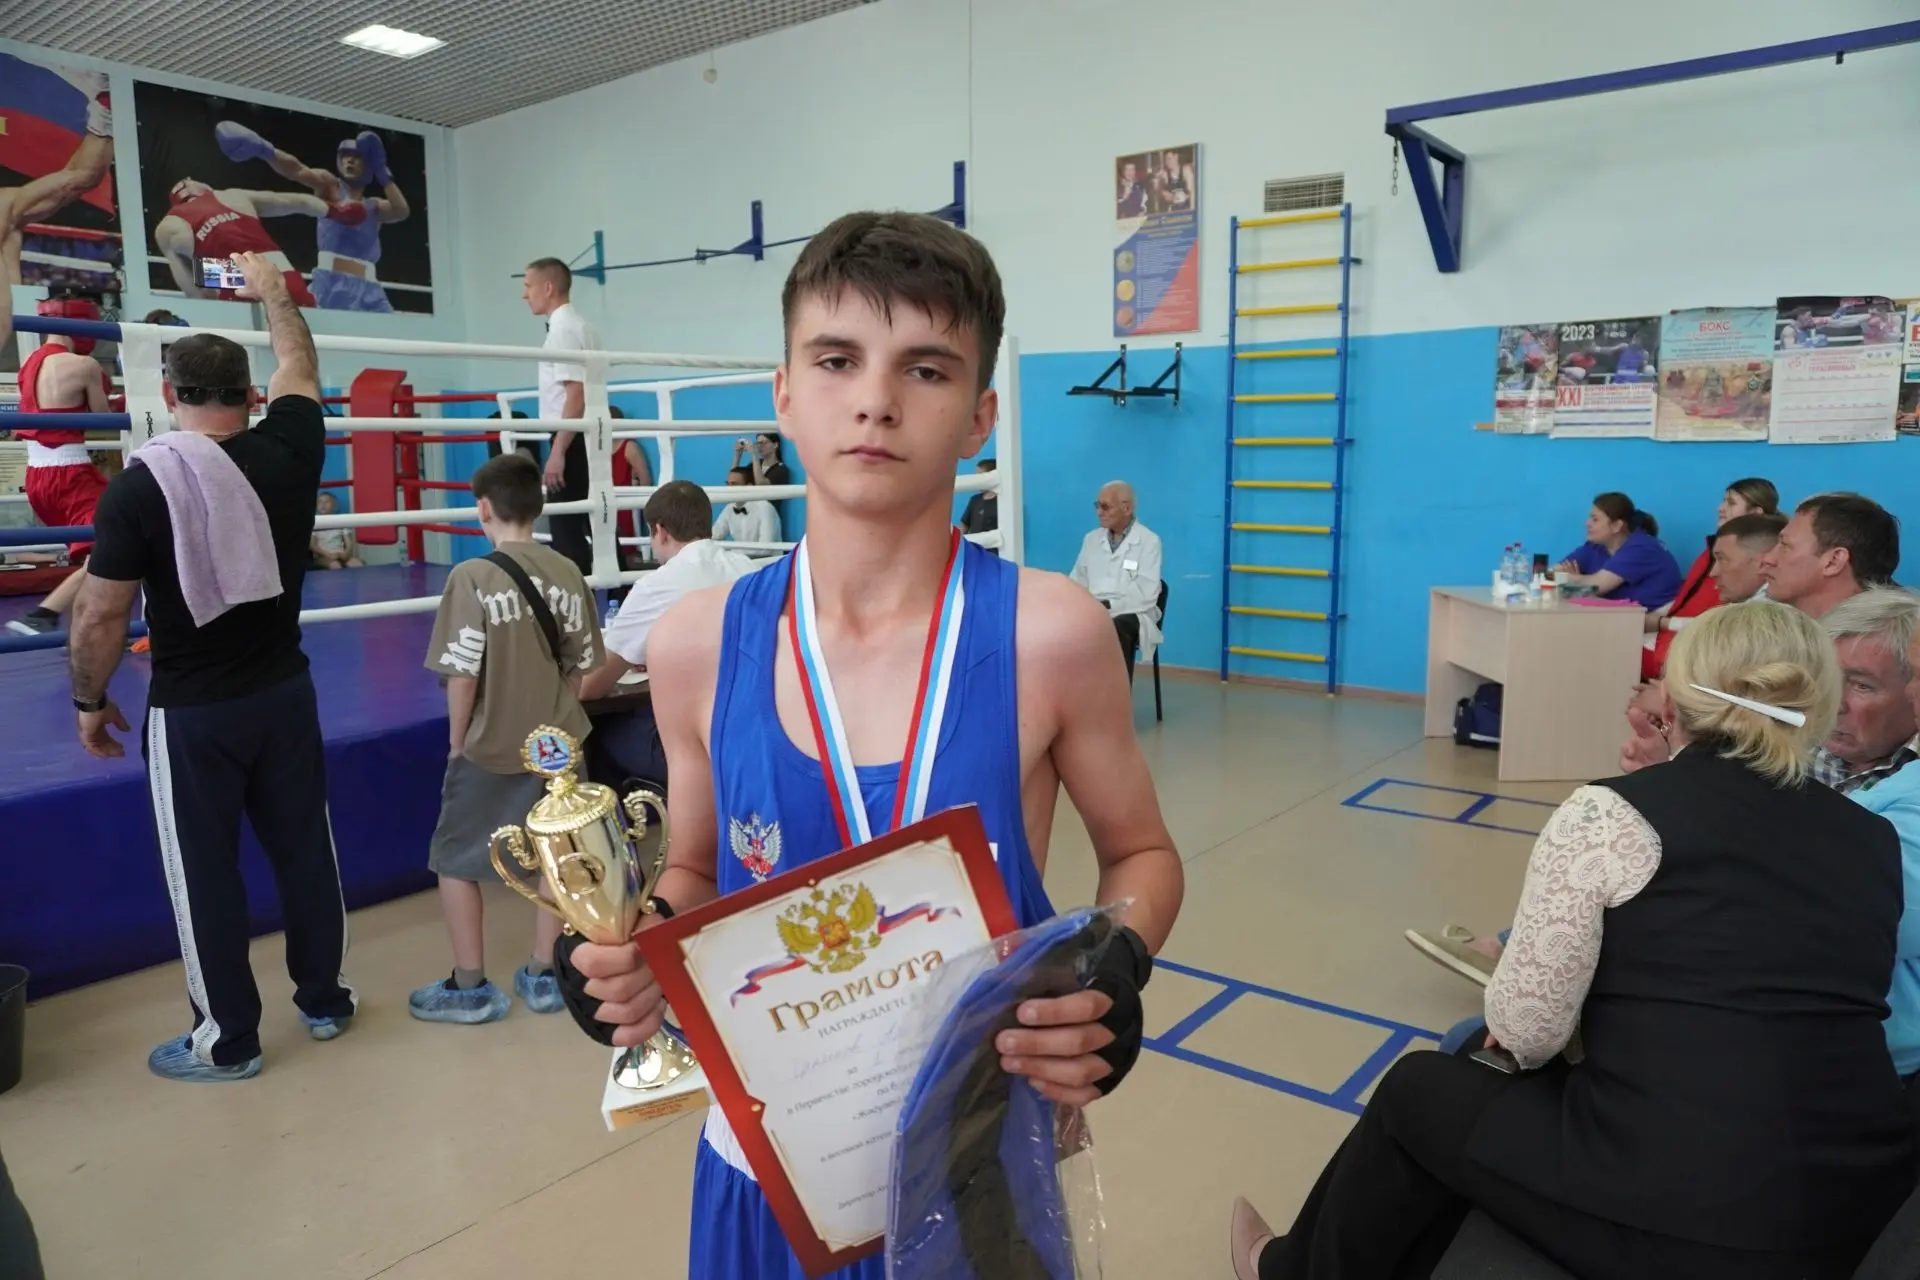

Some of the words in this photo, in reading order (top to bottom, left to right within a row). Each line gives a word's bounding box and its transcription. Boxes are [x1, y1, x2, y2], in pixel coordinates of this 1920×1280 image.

[196, 212, 240, 242] RUSSIA
[1561, 324, 1595, 342] 2023
[1699, 320, 1731, 332] БОКС
[1557, 387, 1581, 408] XXI
[767, 950, 946, 1032] Грамота
